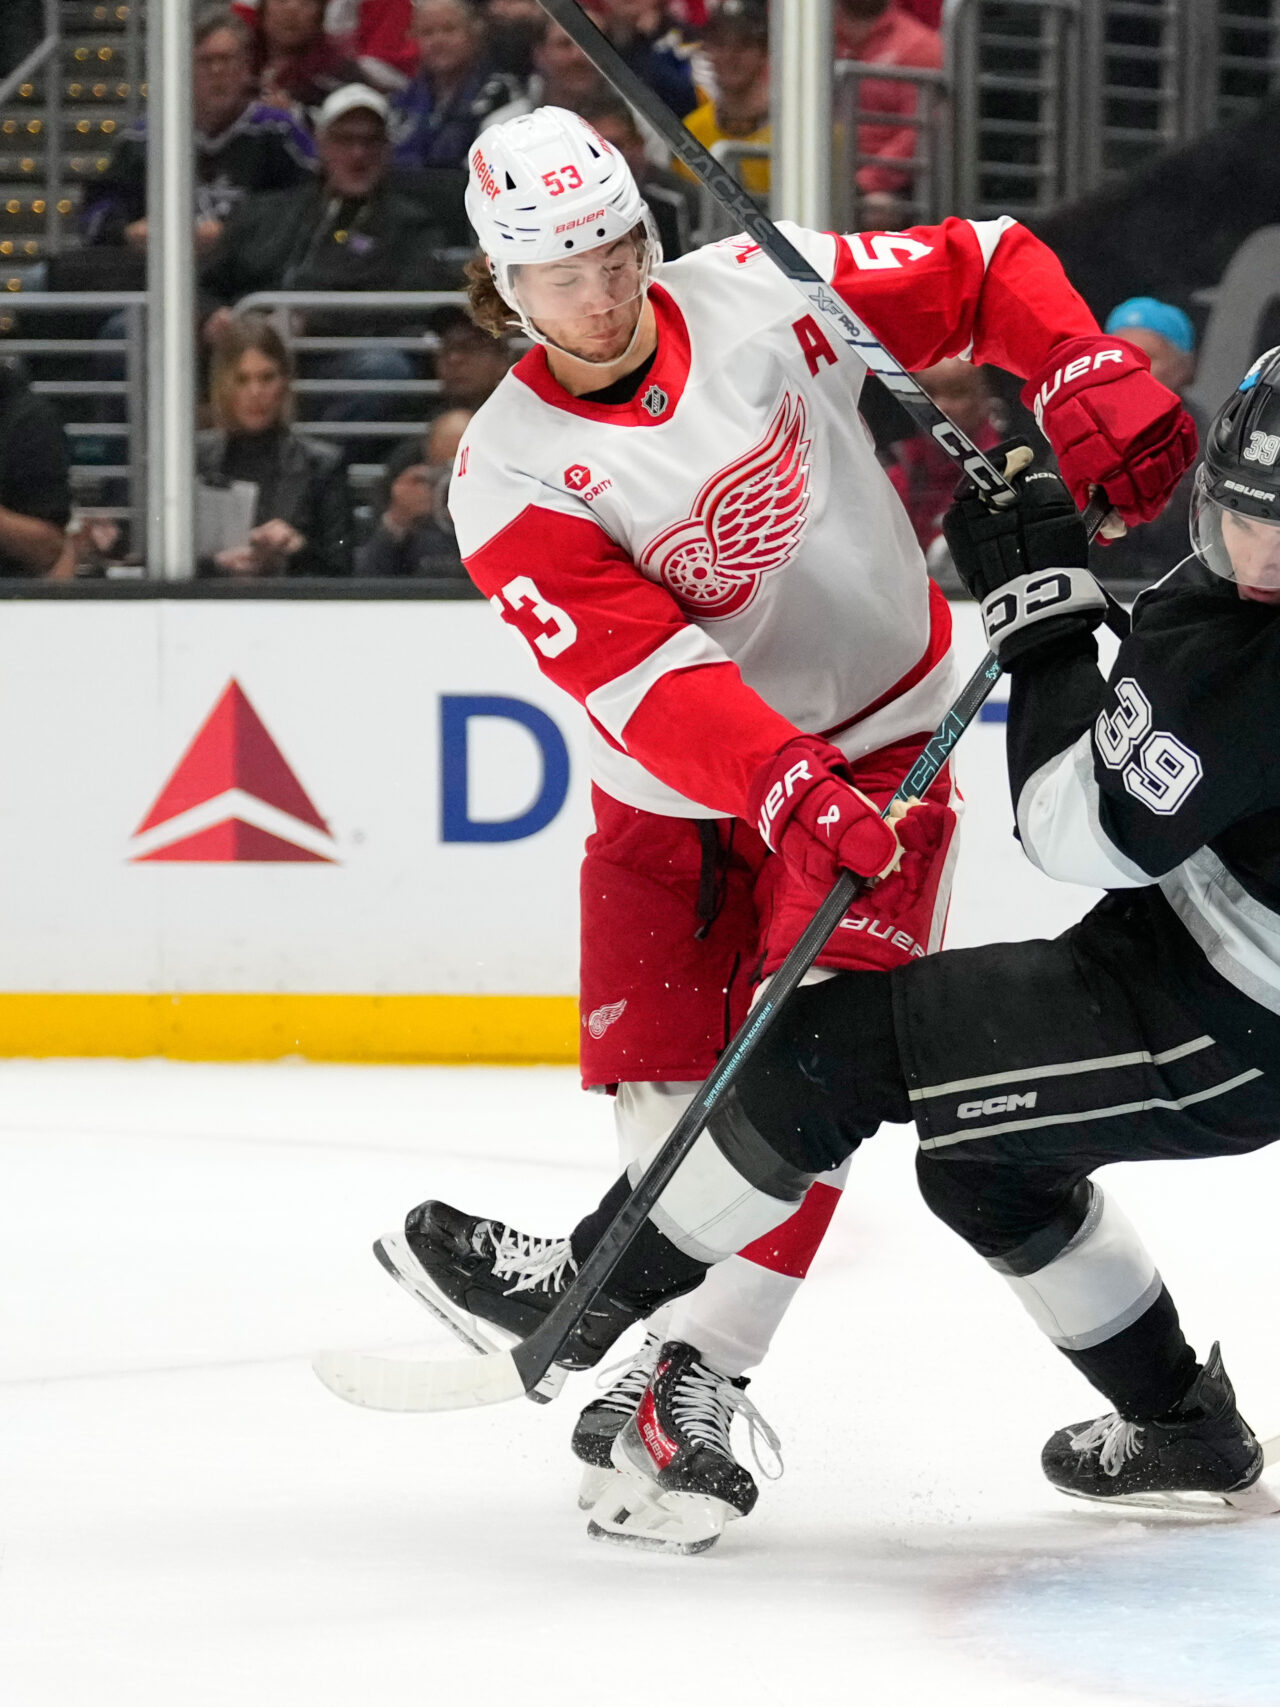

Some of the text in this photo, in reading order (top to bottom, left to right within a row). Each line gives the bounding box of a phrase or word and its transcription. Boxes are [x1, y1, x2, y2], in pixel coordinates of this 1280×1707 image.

[472, 148, 501, 200] meijer
[541, 165, 583, 196] 53
[677, 131, 774, 246] TACKS
[555, 209, 605, 234] BAUER
[846, 229, 935, 271] 5
[791, 313, 838, 378] A
[838, 314, 861, 337] PRO
[1033, 349, 1123, 444] AUER
[932, 421, 1017, 505] CC
[1223, 479, 1276, 502] BAUER
[884, 710, 966, 815] CM
[1094, 677, 1204, 815] 39
[757, 759, 813, 854] UER
[839, 915, 926, 961] AUER
[956, 1091, 1037, 1119] CCM
